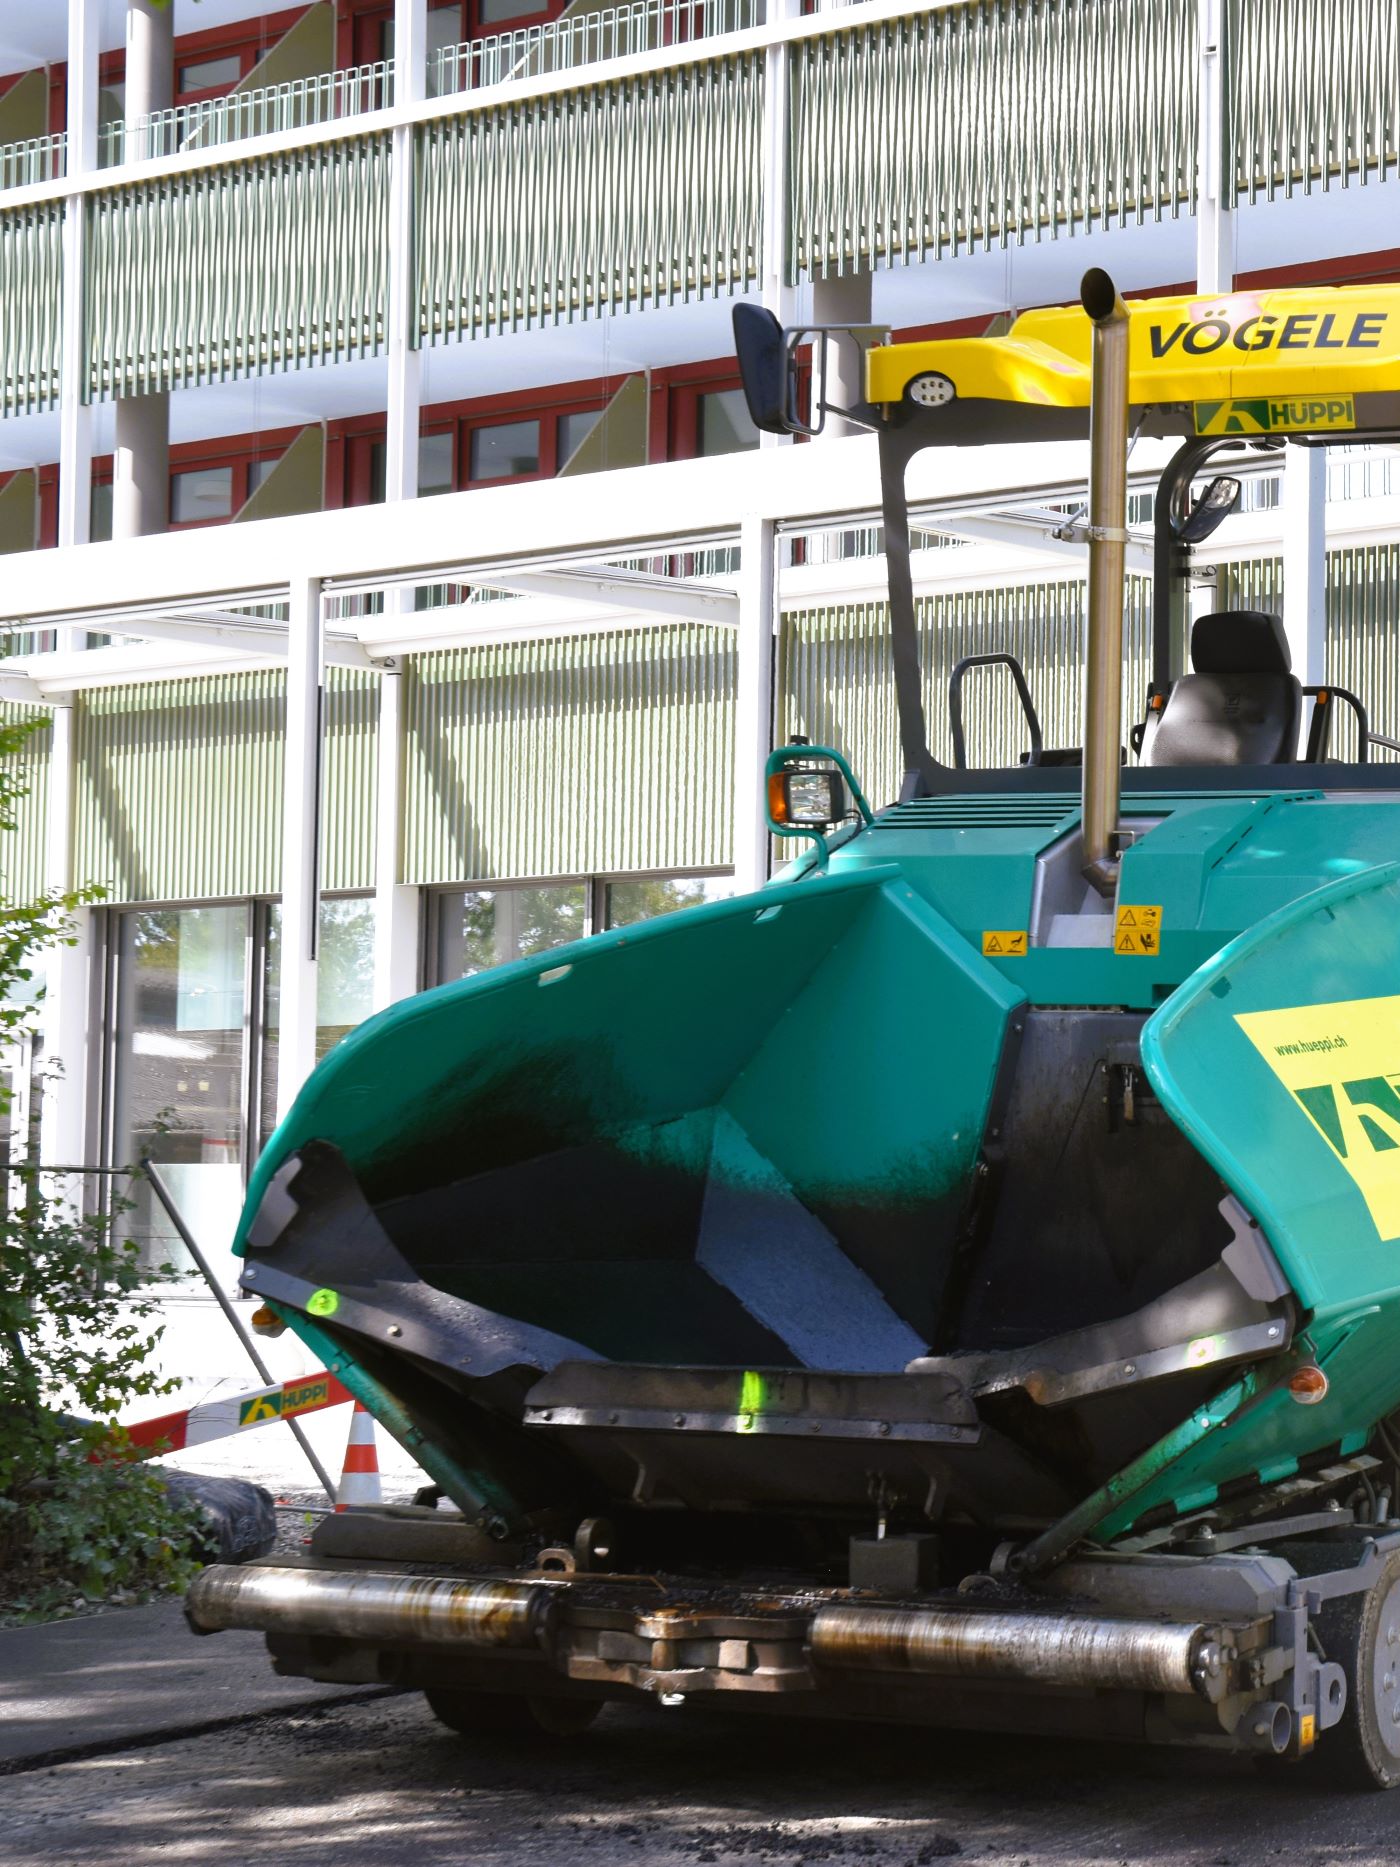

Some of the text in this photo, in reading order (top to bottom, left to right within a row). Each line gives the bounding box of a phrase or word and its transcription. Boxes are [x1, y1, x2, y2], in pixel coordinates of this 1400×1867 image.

[1150, 309, 1388, 358] VÖGELE
[1271, 400, 1353, 425] HÜPPI
[1274, 1035, 1348, 1056] www.hueppi.ch
